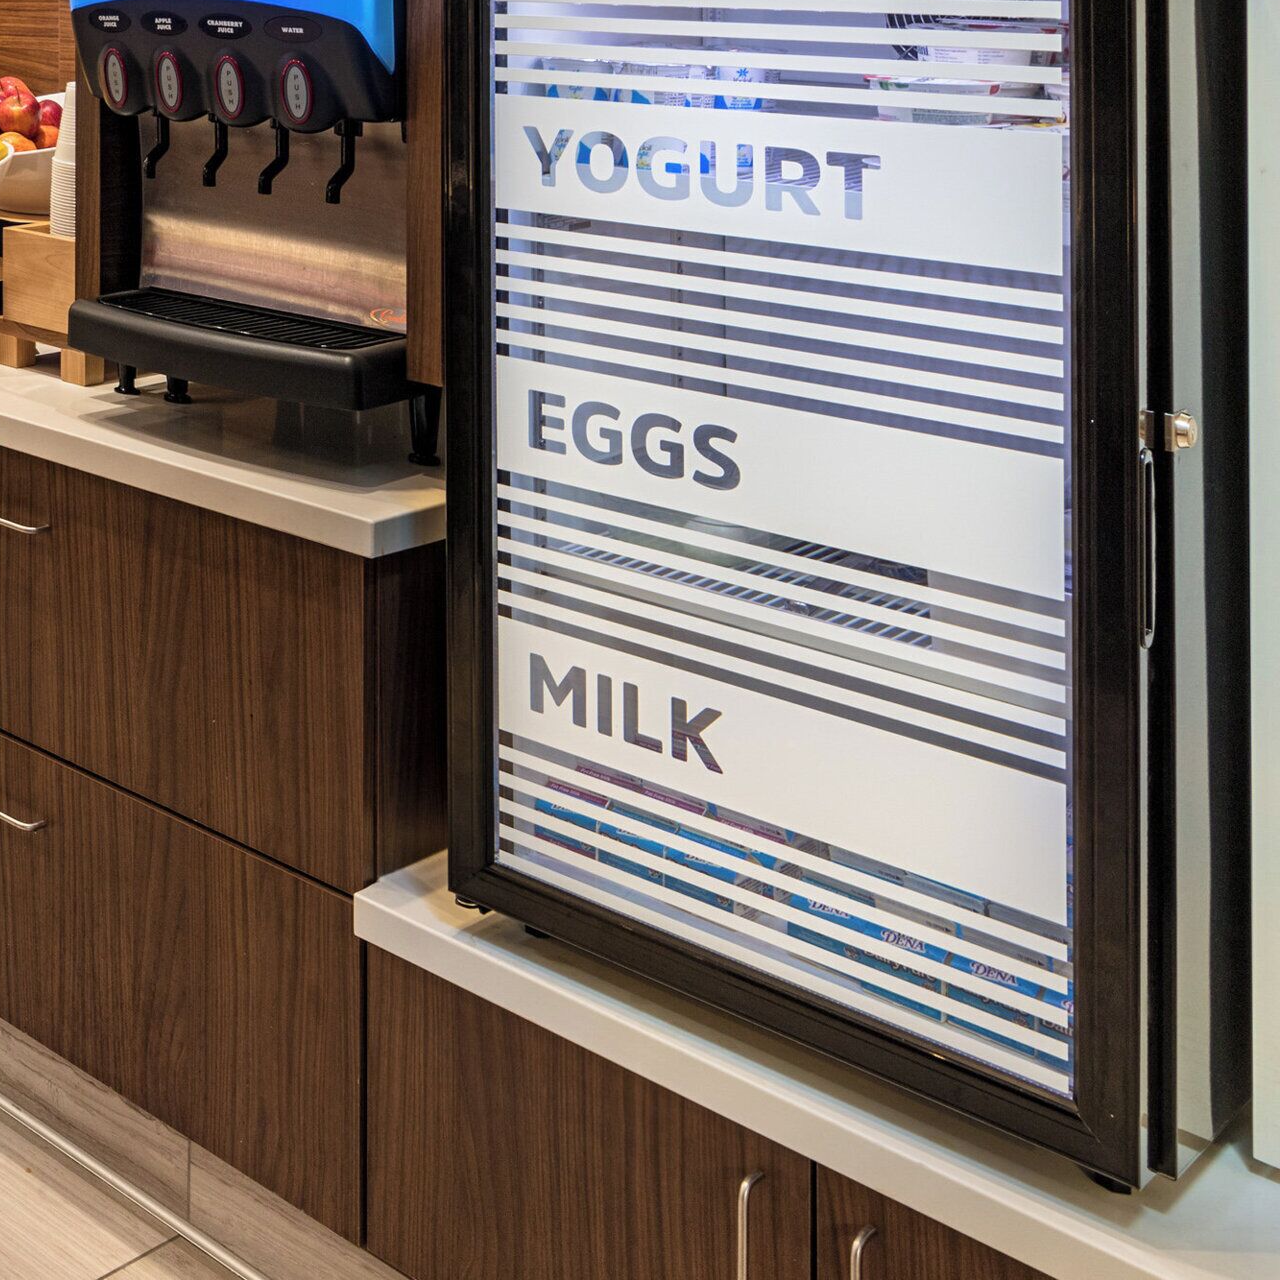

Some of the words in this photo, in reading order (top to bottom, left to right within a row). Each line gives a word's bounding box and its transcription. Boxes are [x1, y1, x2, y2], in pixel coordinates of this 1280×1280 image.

[156, 23, 172, 31] JUICE
[206, 19, 244, 29] CRANBERRY
[217, 26, 235, 34] JUICE
[281, 26, 305, 35] WATER
[226, 69, 234, 106] PUSH
[293, 73, 301, 110] PUSH
[522, 125, 881, 220] YOGURT
[528, 389, 741, 491] EGGS
[529, 652, 724, 775] MILK
[971, 961, 1018, 984] DENA
